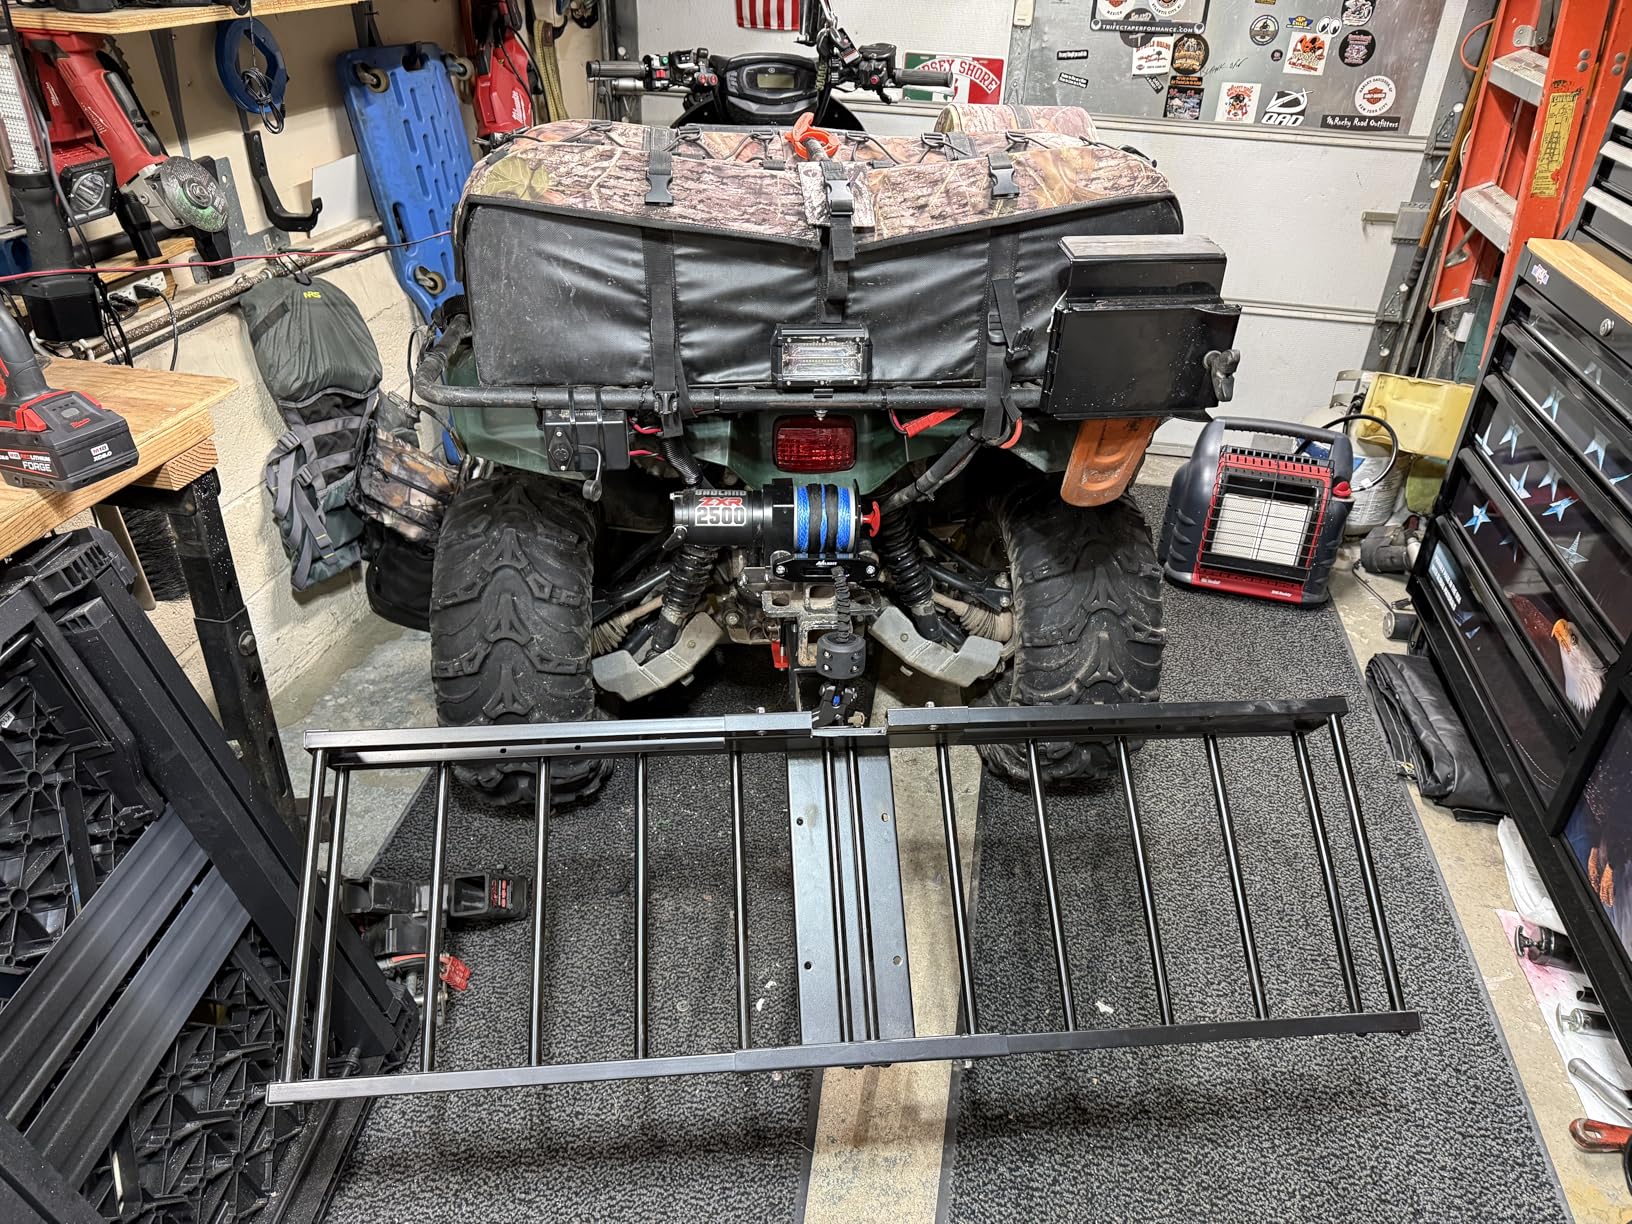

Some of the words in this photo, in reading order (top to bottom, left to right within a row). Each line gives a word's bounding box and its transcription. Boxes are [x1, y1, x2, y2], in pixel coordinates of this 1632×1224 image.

[1102, 23, 1193, 33] TRIFECTAPERFORMANCE.COM
[958, 60, 998, 91] SHORE
[1261, 112, 1305, 127] QAD
[1333, 116, 1351, 128] Rocky
[1352, 117, 1369, 127] Road
[1369, 118, 1399, 128] Outfitters
[22, 461, 52, 472] FORGE
[699, 496, 743, 507] ZXR
[695, 506, 747, 526] 2500
